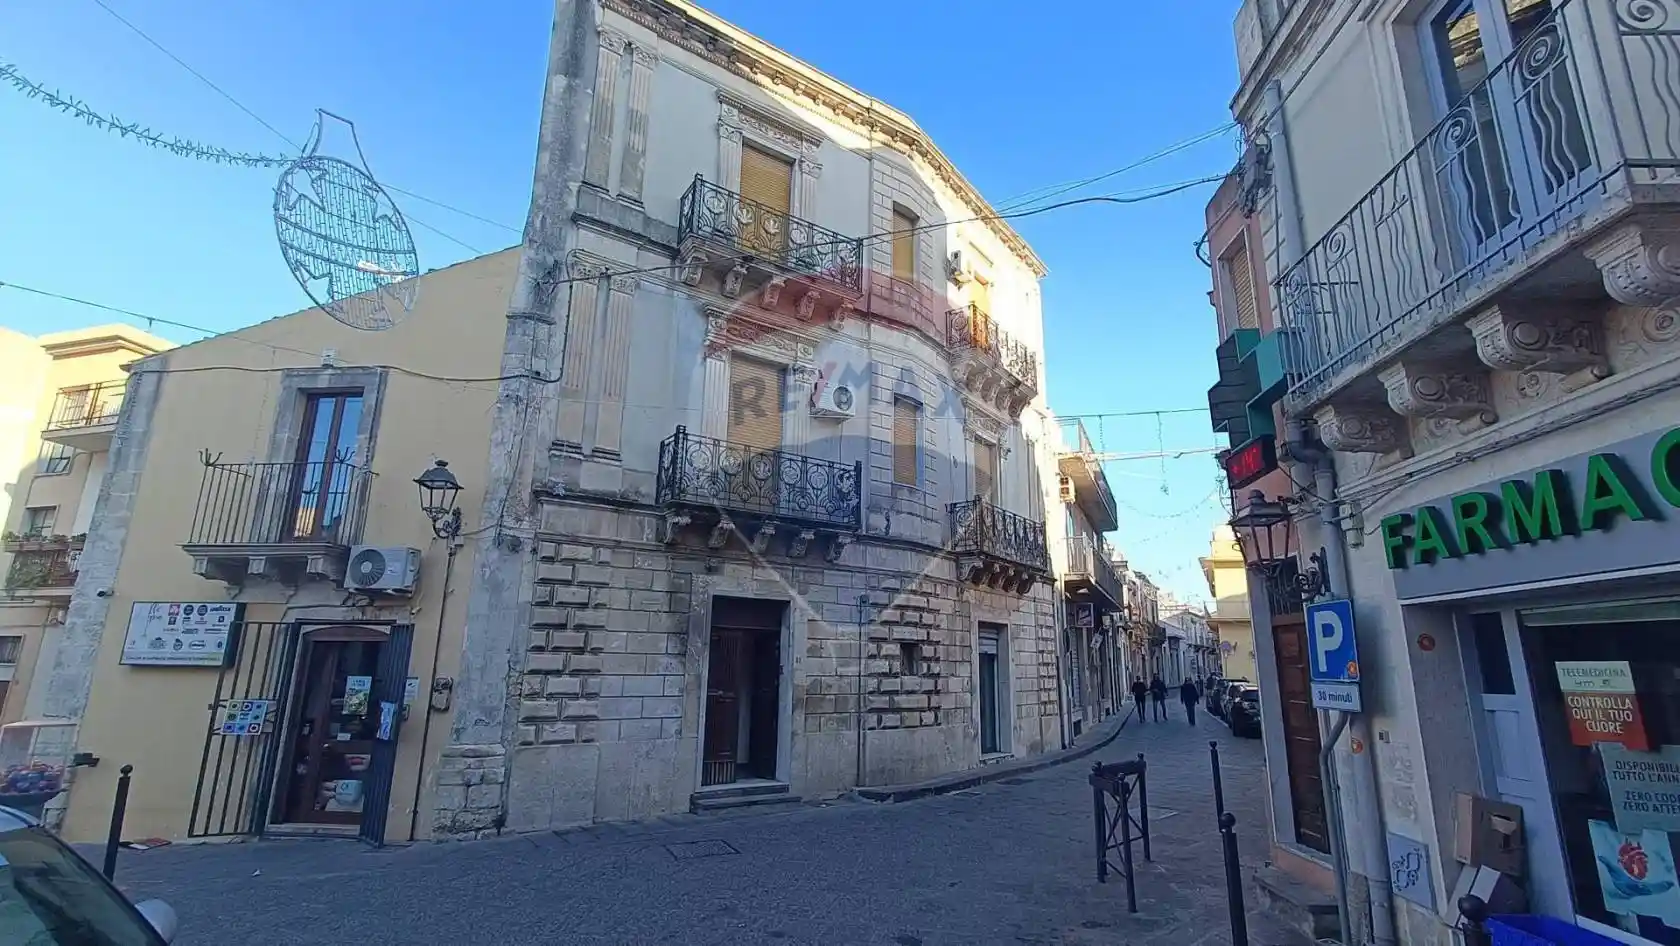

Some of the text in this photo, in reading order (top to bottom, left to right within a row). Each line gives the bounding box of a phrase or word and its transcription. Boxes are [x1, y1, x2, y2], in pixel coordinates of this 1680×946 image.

[1314, 610, 1343, 672] P
[1561, 667, 1627, 678] TELEMEDICINA
[1318, 690, 1353, 703] 30 minuti
[1568, 695, 1633, 710] CONTROLLA
[1572, 707, 1632, 722] QUI IL TUO
[1586, 719, 1624, 734] CUORE
[1612, 770, 1645, 782] TUTTO
[1625, 790, 1652, 802] ZERO
[1623, 801, 1649, 812] ZERO
